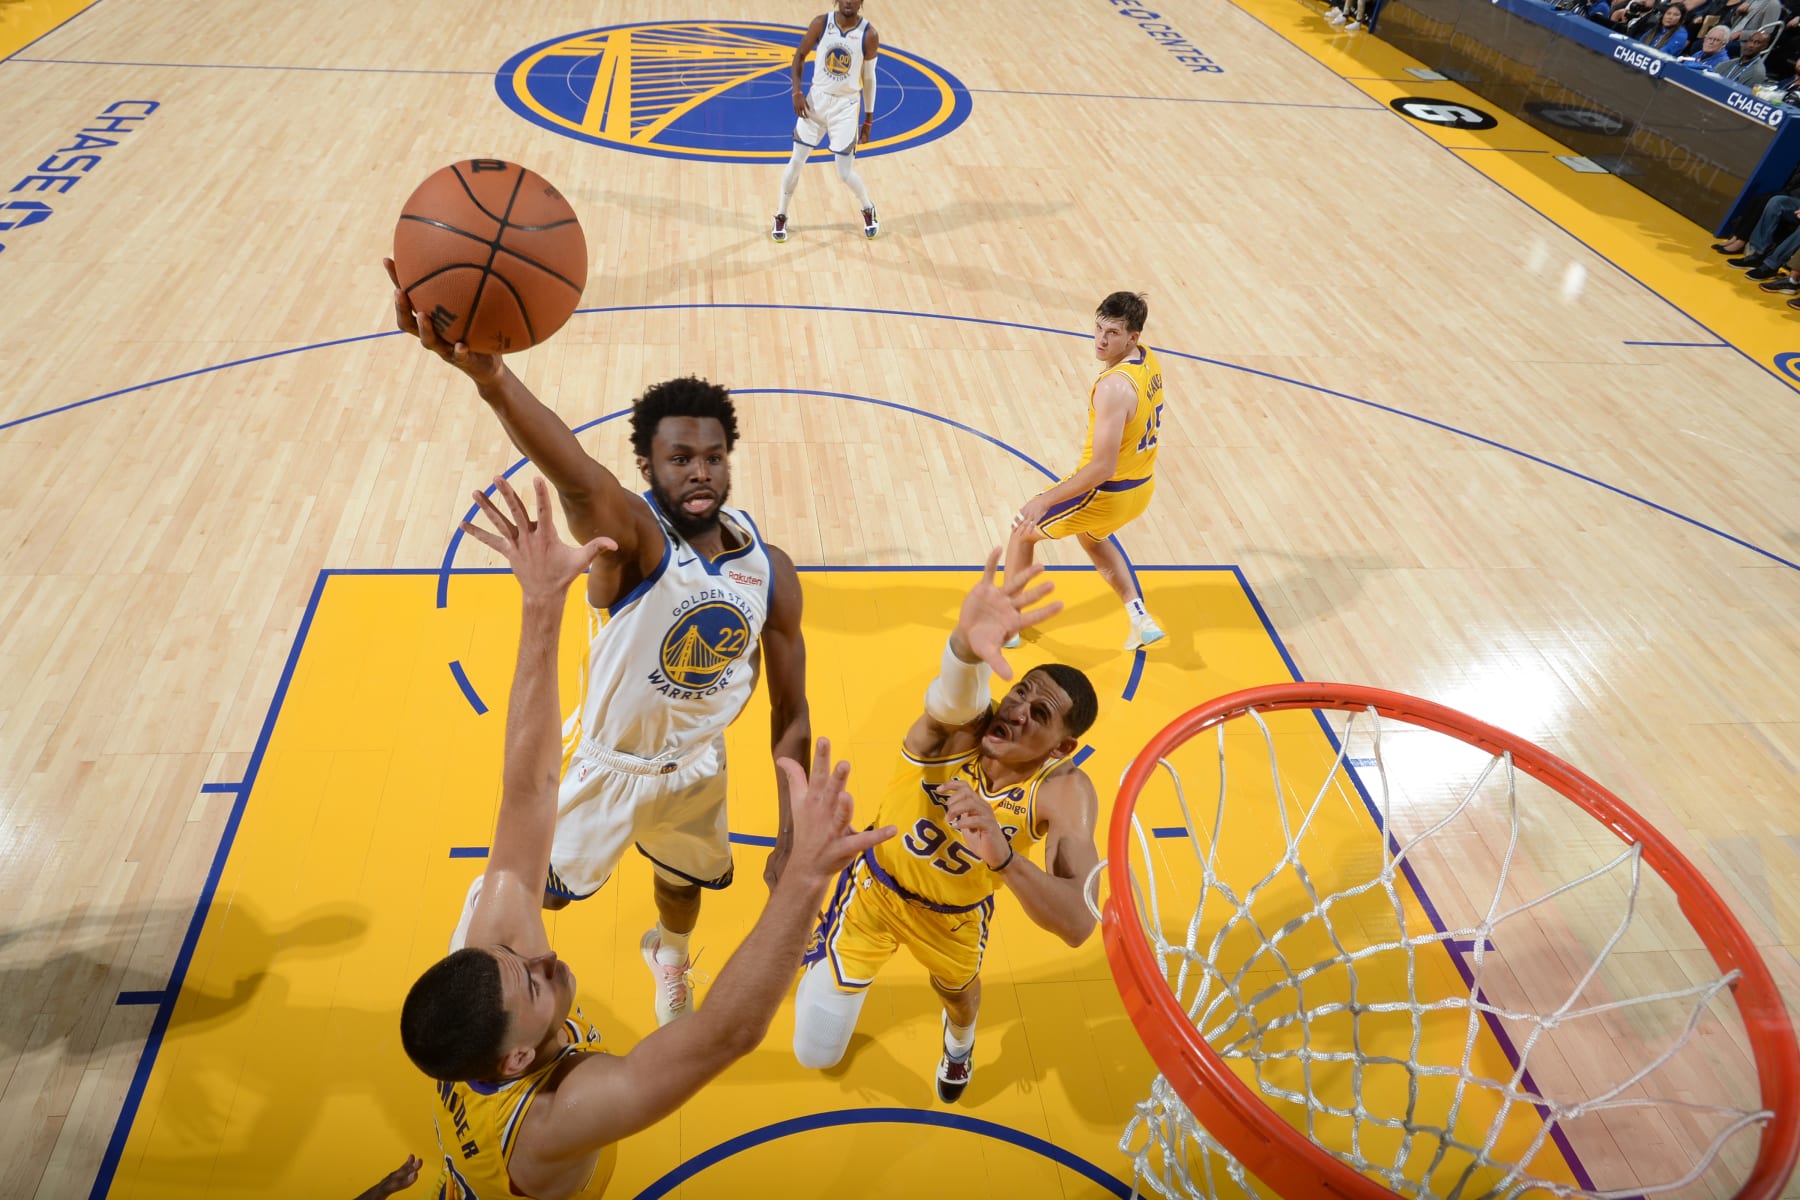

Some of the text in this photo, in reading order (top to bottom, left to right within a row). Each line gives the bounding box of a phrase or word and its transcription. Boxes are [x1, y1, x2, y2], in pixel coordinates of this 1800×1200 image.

[1138, 22, 1225, 74] CENTER
[1613, 44, 1651, 72] CHASE
[1727, 91, 1770, 121] CHASE
[8, 100, 161, 194] CHASE
[728, 570, 763, 586] Rakuten
[672, 588, 754, 622] GOLDEN STATE
[714, 627, 746, 652] 22
[648, 667, 734, 701] WARRIORS
[902, 818, 983, 876] 95
